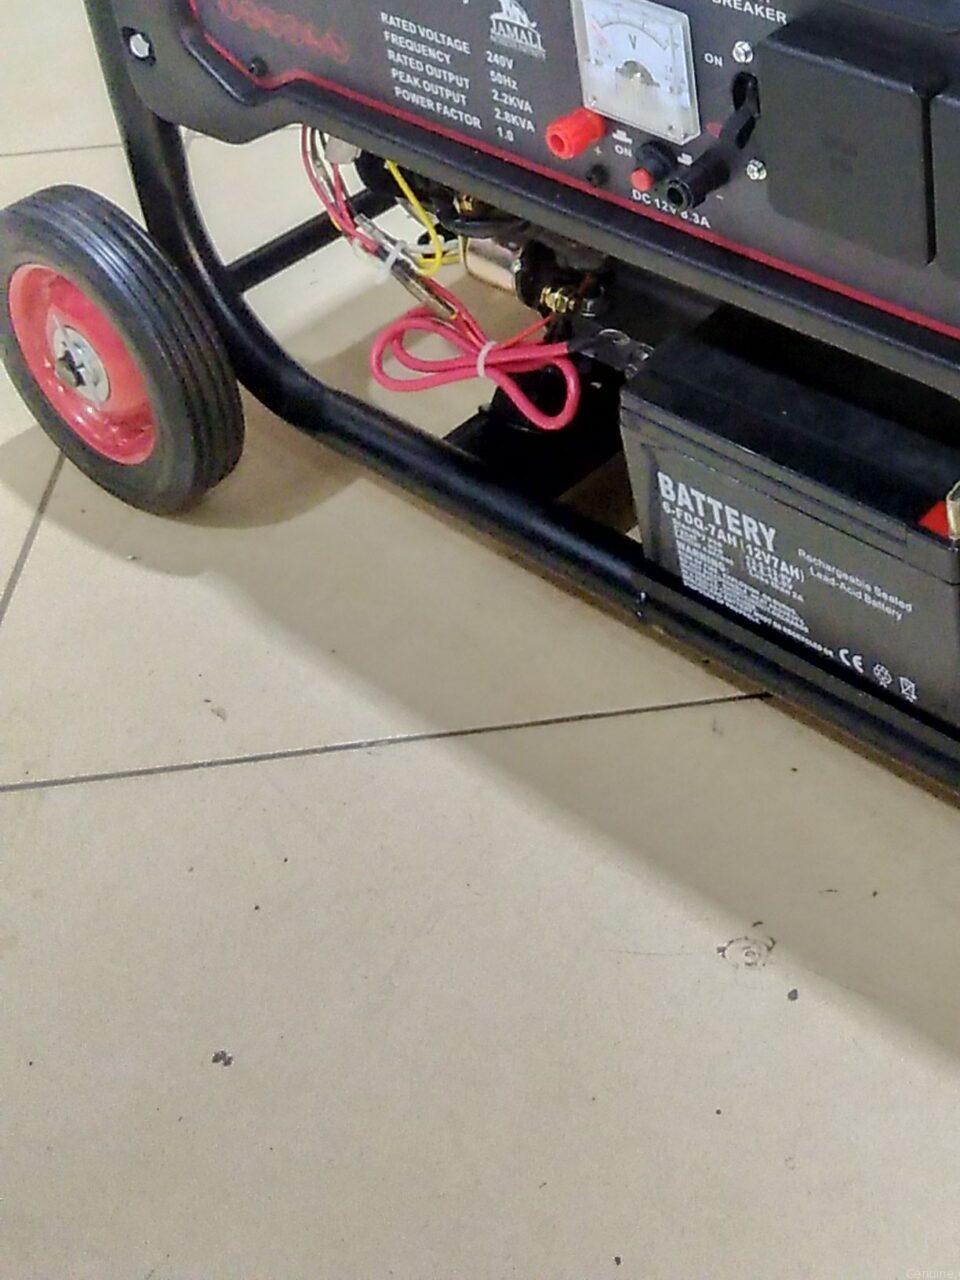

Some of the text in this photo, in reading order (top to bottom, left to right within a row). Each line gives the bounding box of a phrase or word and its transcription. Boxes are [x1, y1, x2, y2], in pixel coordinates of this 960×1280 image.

[380, 11, 417, 35] RATED
[417, 24, 471, 55] VOLTAGE
[383, 30, 451, 65] FREQUENCY
[628, 33, 637, 50] V
[387, 49, 470, 90] RATED OUTPUT
[704, 52, 723, 67] ON
[391, 67, 467, 106] PEAK OUTPUT
[394, 86, 482, 130] POWER FACTOR
[614, 146, 633, 158] ON
[632, 189, 651, 205] DC
[657, 471, 776, 553] BATTERY
[839, 648, 864, 674] CE
